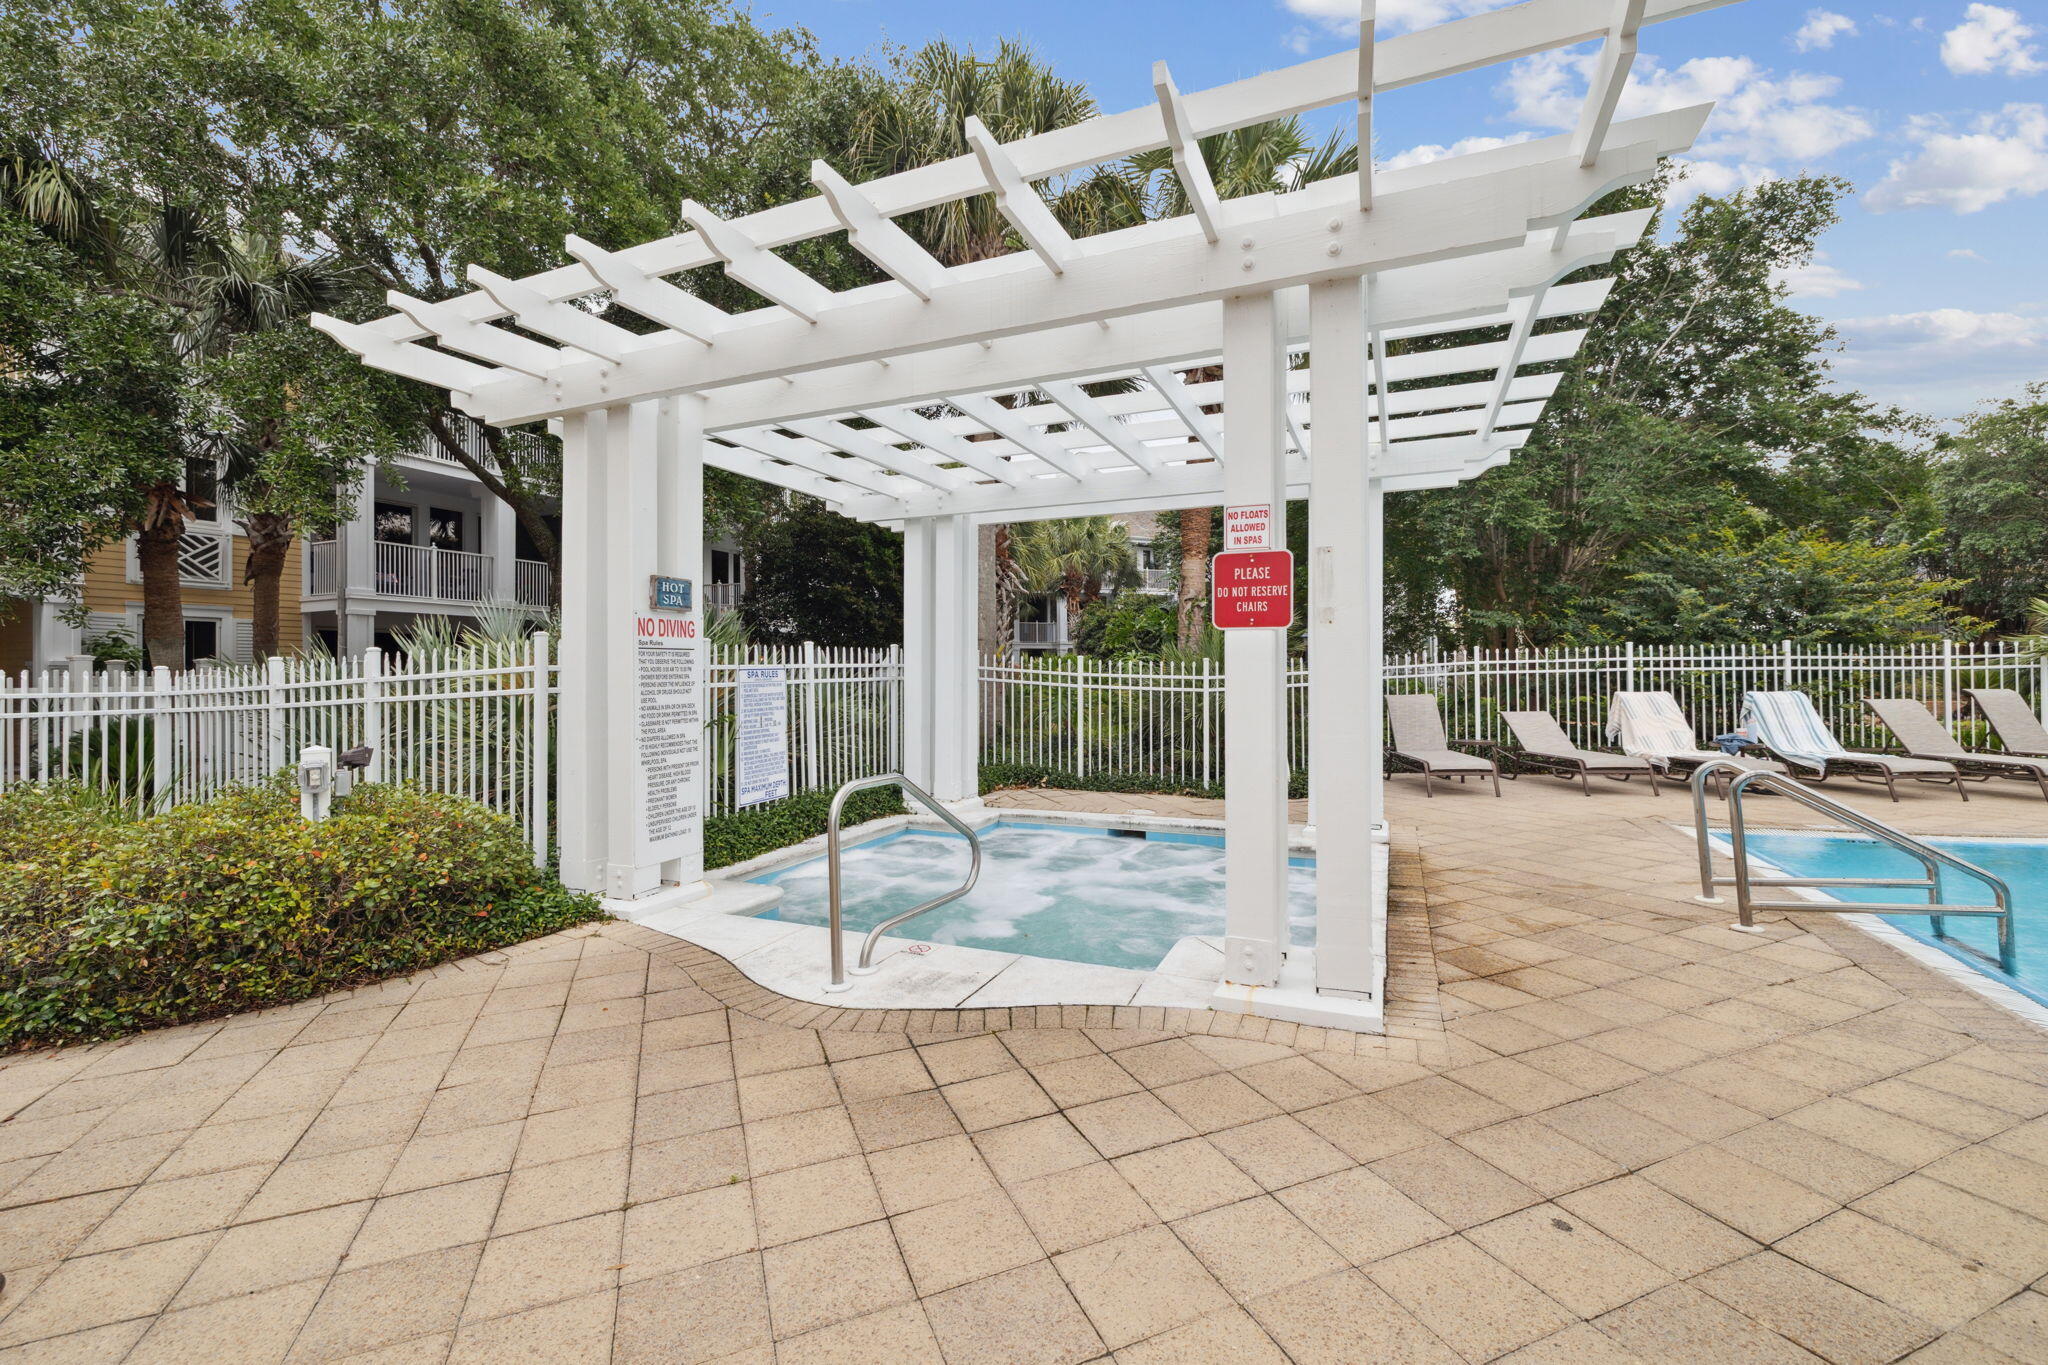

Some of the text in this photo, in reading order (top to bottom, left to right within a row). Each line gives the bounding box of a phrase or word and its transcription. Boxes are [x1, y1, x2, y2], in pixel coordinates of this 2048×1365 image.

[1228, 510, 1268, 520] NO FLOATS
[1230, 523, 1266, 533] ALLOWED
[1234, 536, 1262, 545] IN SPAS
[1234, 567, 1270, 580] PLEASE
[662, 581, 685, 594] HOT
[1217, 585, 1288, 598] DO NOT RESERVE
[663, 594, 683, 606] SPA
[1236, 602, 1268, 612] CHAIRS
[638, 617, 695, 639] NO DIVING
[742, 786, 750, 795] SPA
[751, 782, 772, 792] MAXIMUM
[765, 789, 777, 798] FEET
